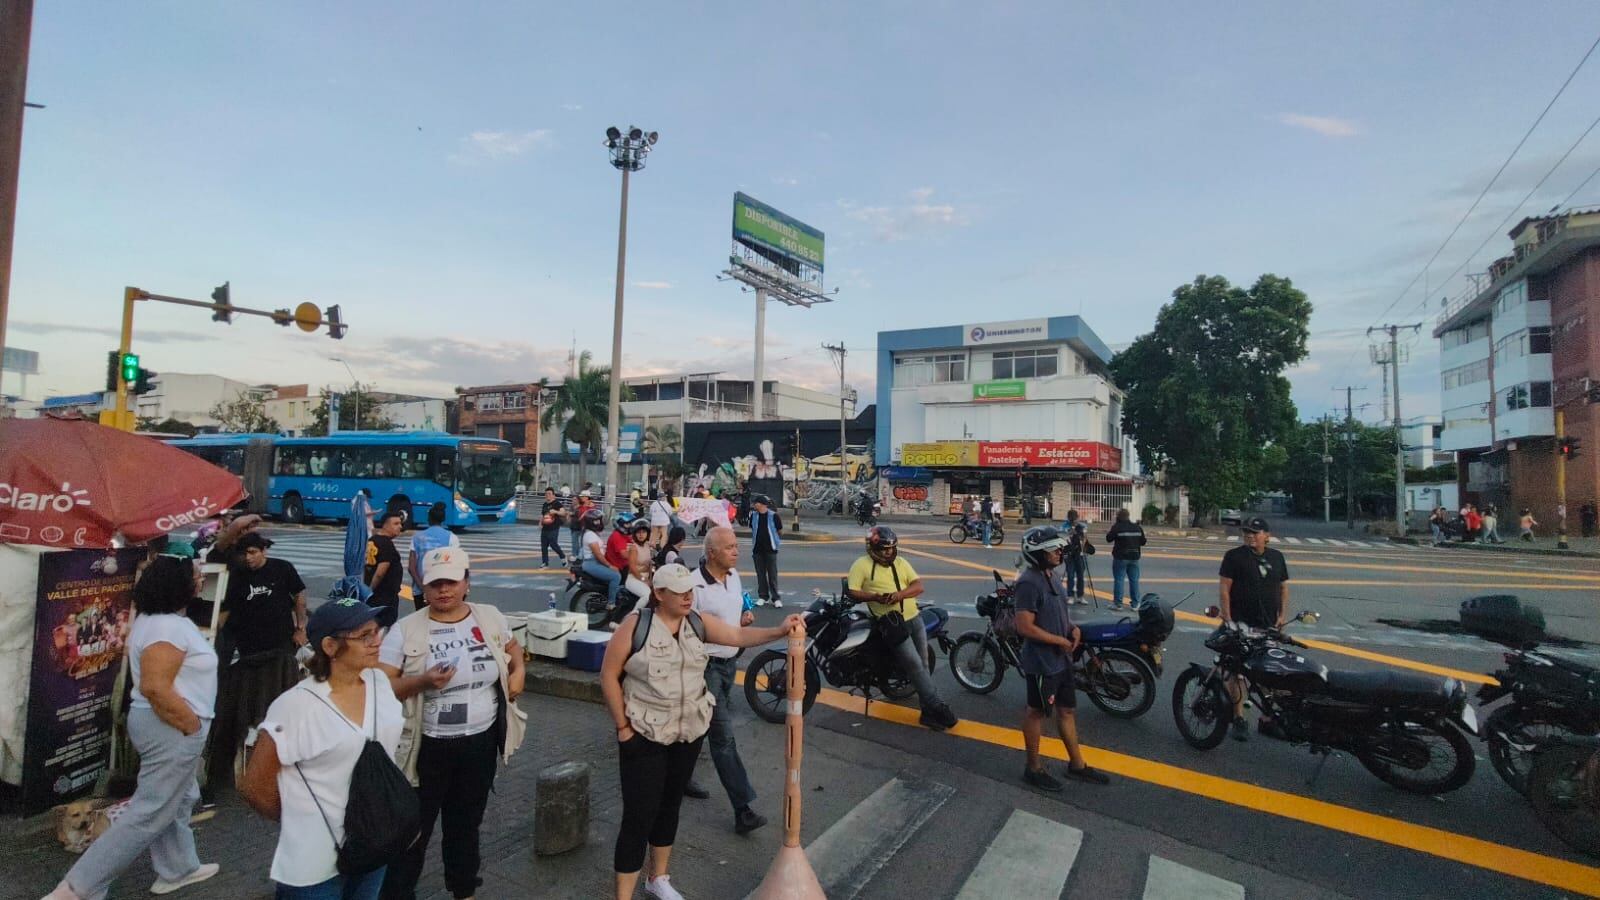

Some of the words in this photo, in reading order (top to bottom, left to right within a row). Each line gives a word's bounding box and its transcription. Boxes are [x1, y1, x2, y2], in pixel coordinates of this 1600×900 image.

[904, 453, 958, 465] POLLO
[1038, 447, 1090, 458] Estación
[155, 504, 209, 532] Claro
[46, 589, 79, 600] VALLE
[80, 586, 100, 597] DEL
